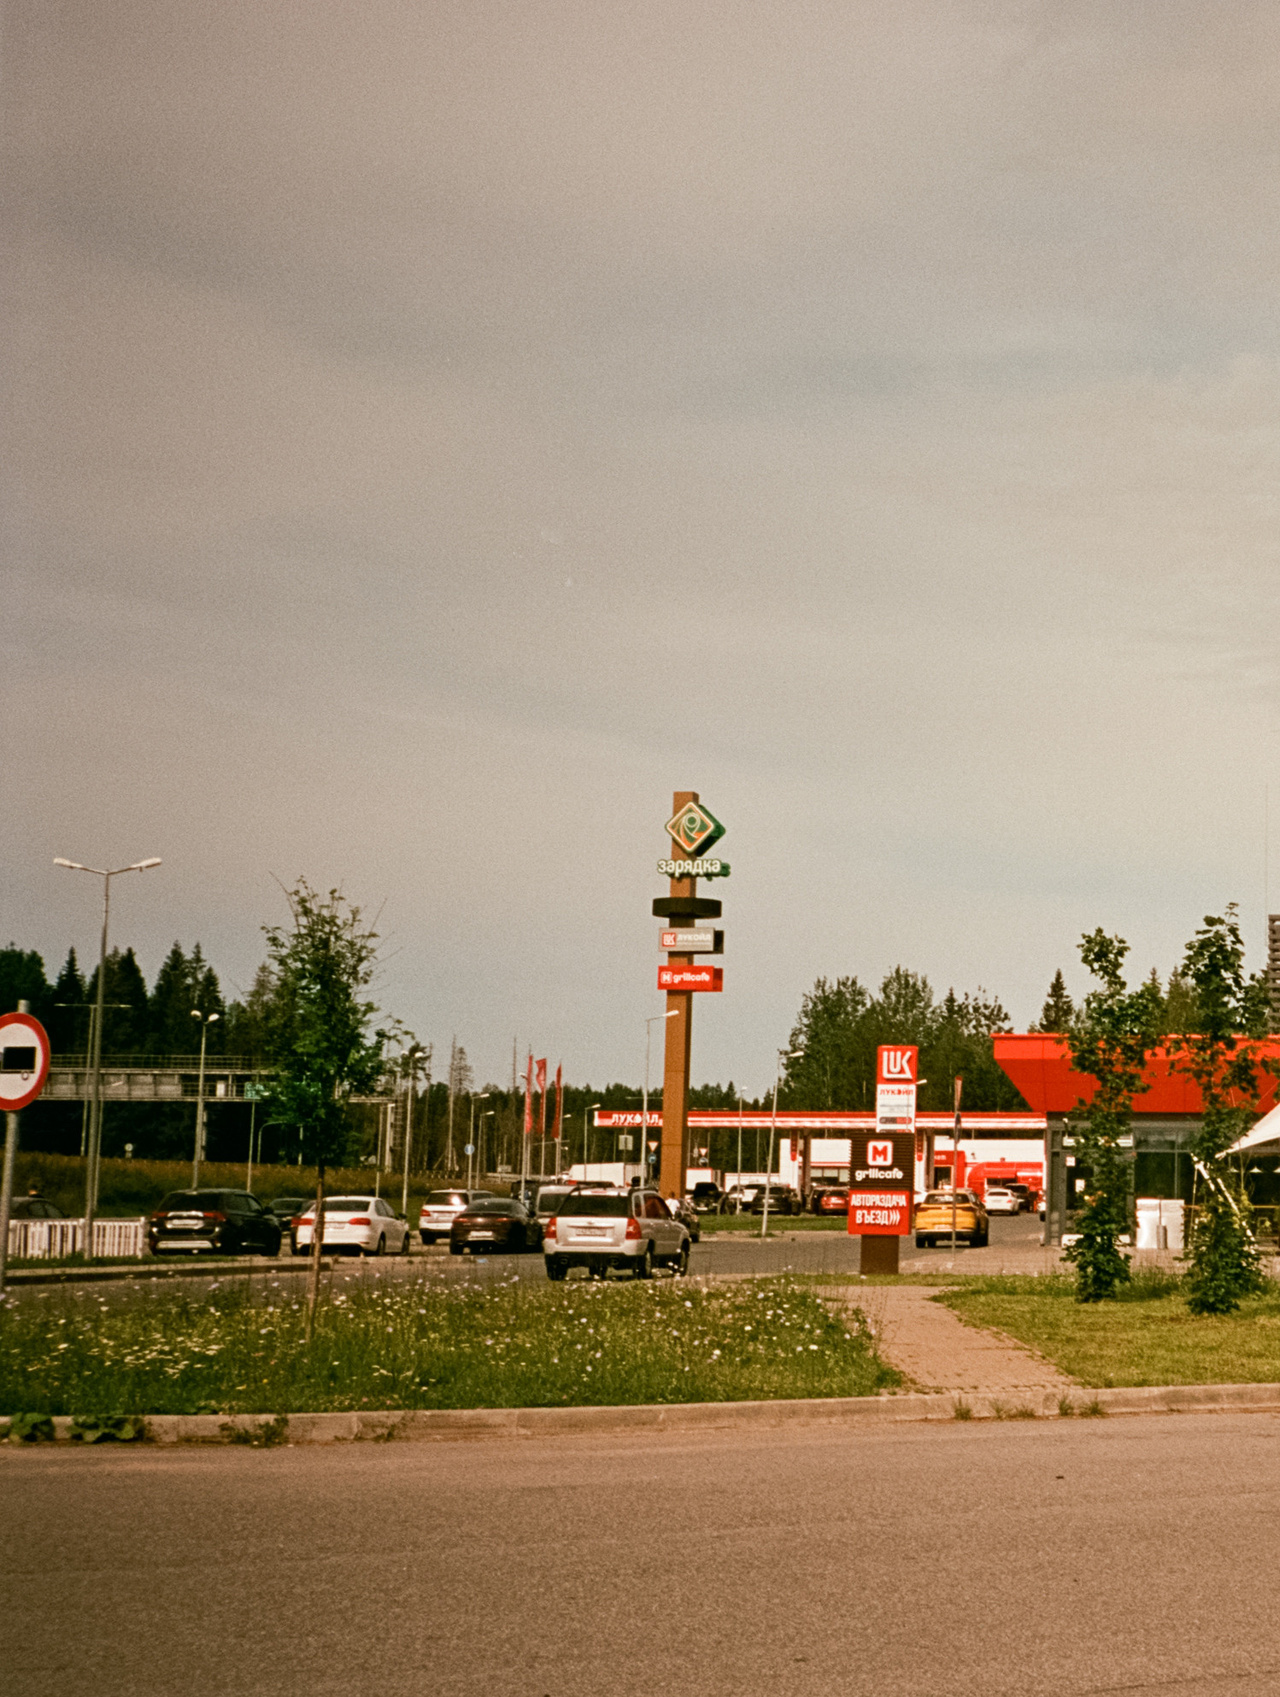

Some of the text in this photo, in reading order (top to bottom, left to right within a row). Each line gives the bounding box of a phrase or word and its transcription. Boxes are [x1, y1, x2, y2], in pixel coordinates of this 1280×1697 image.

[658, 859, 721, 878] зарядка
[673, 971, 711, 984] grillcafe
[855, 1167, 904, 1182] grillcafe
[850, 1193, 908, 1208] АВТОРАЗДАЧА
